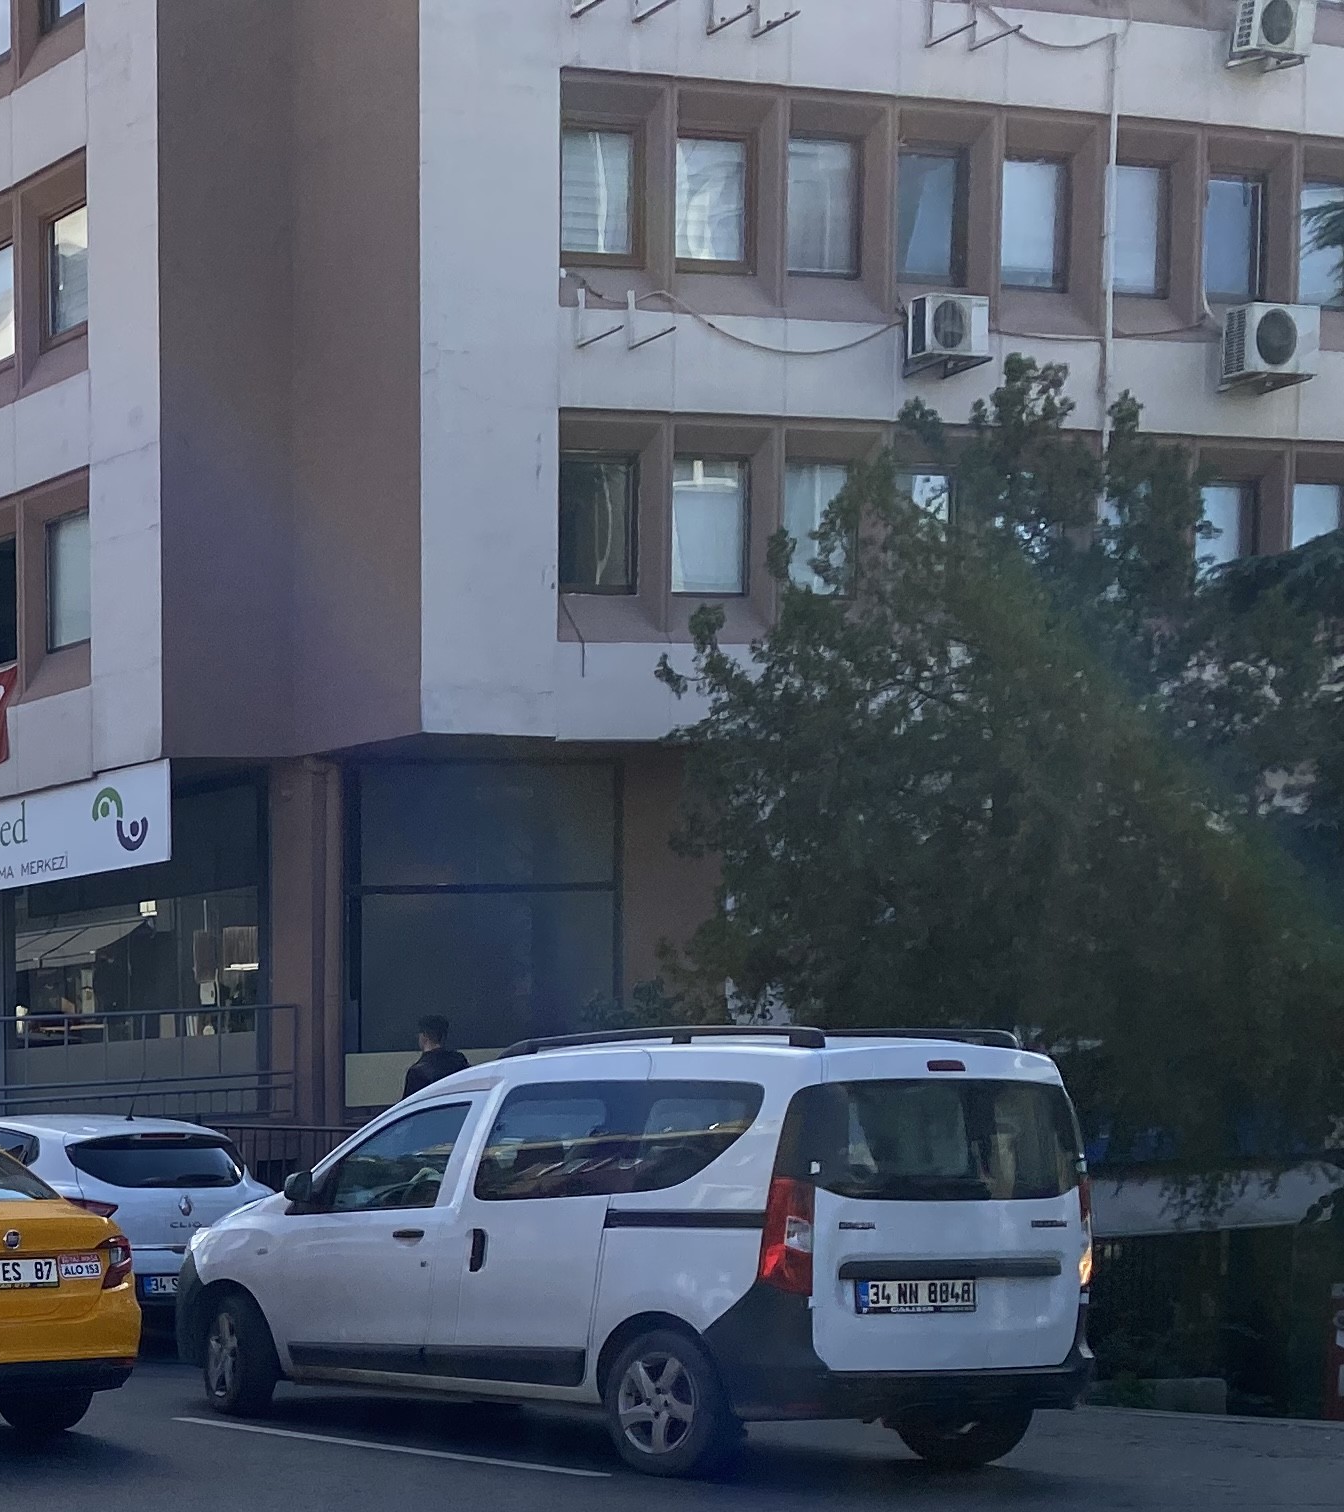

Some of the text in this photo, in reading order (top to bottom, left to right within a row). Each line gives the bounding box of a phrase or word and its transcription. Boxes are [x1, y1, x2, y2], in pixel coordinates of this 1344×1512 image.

[20, 851, 69, 877] MERKEZİ
[170, 1221, 202, 1229] CLIO
[34, 1261, 52, 1280] 87
[64, 1264, 100, 1275] ALO 153
[151, 1278, 166, 1291] 34
[870, 1284, 891, 1305] 34
[898, 1283, 919, 1304] NN
